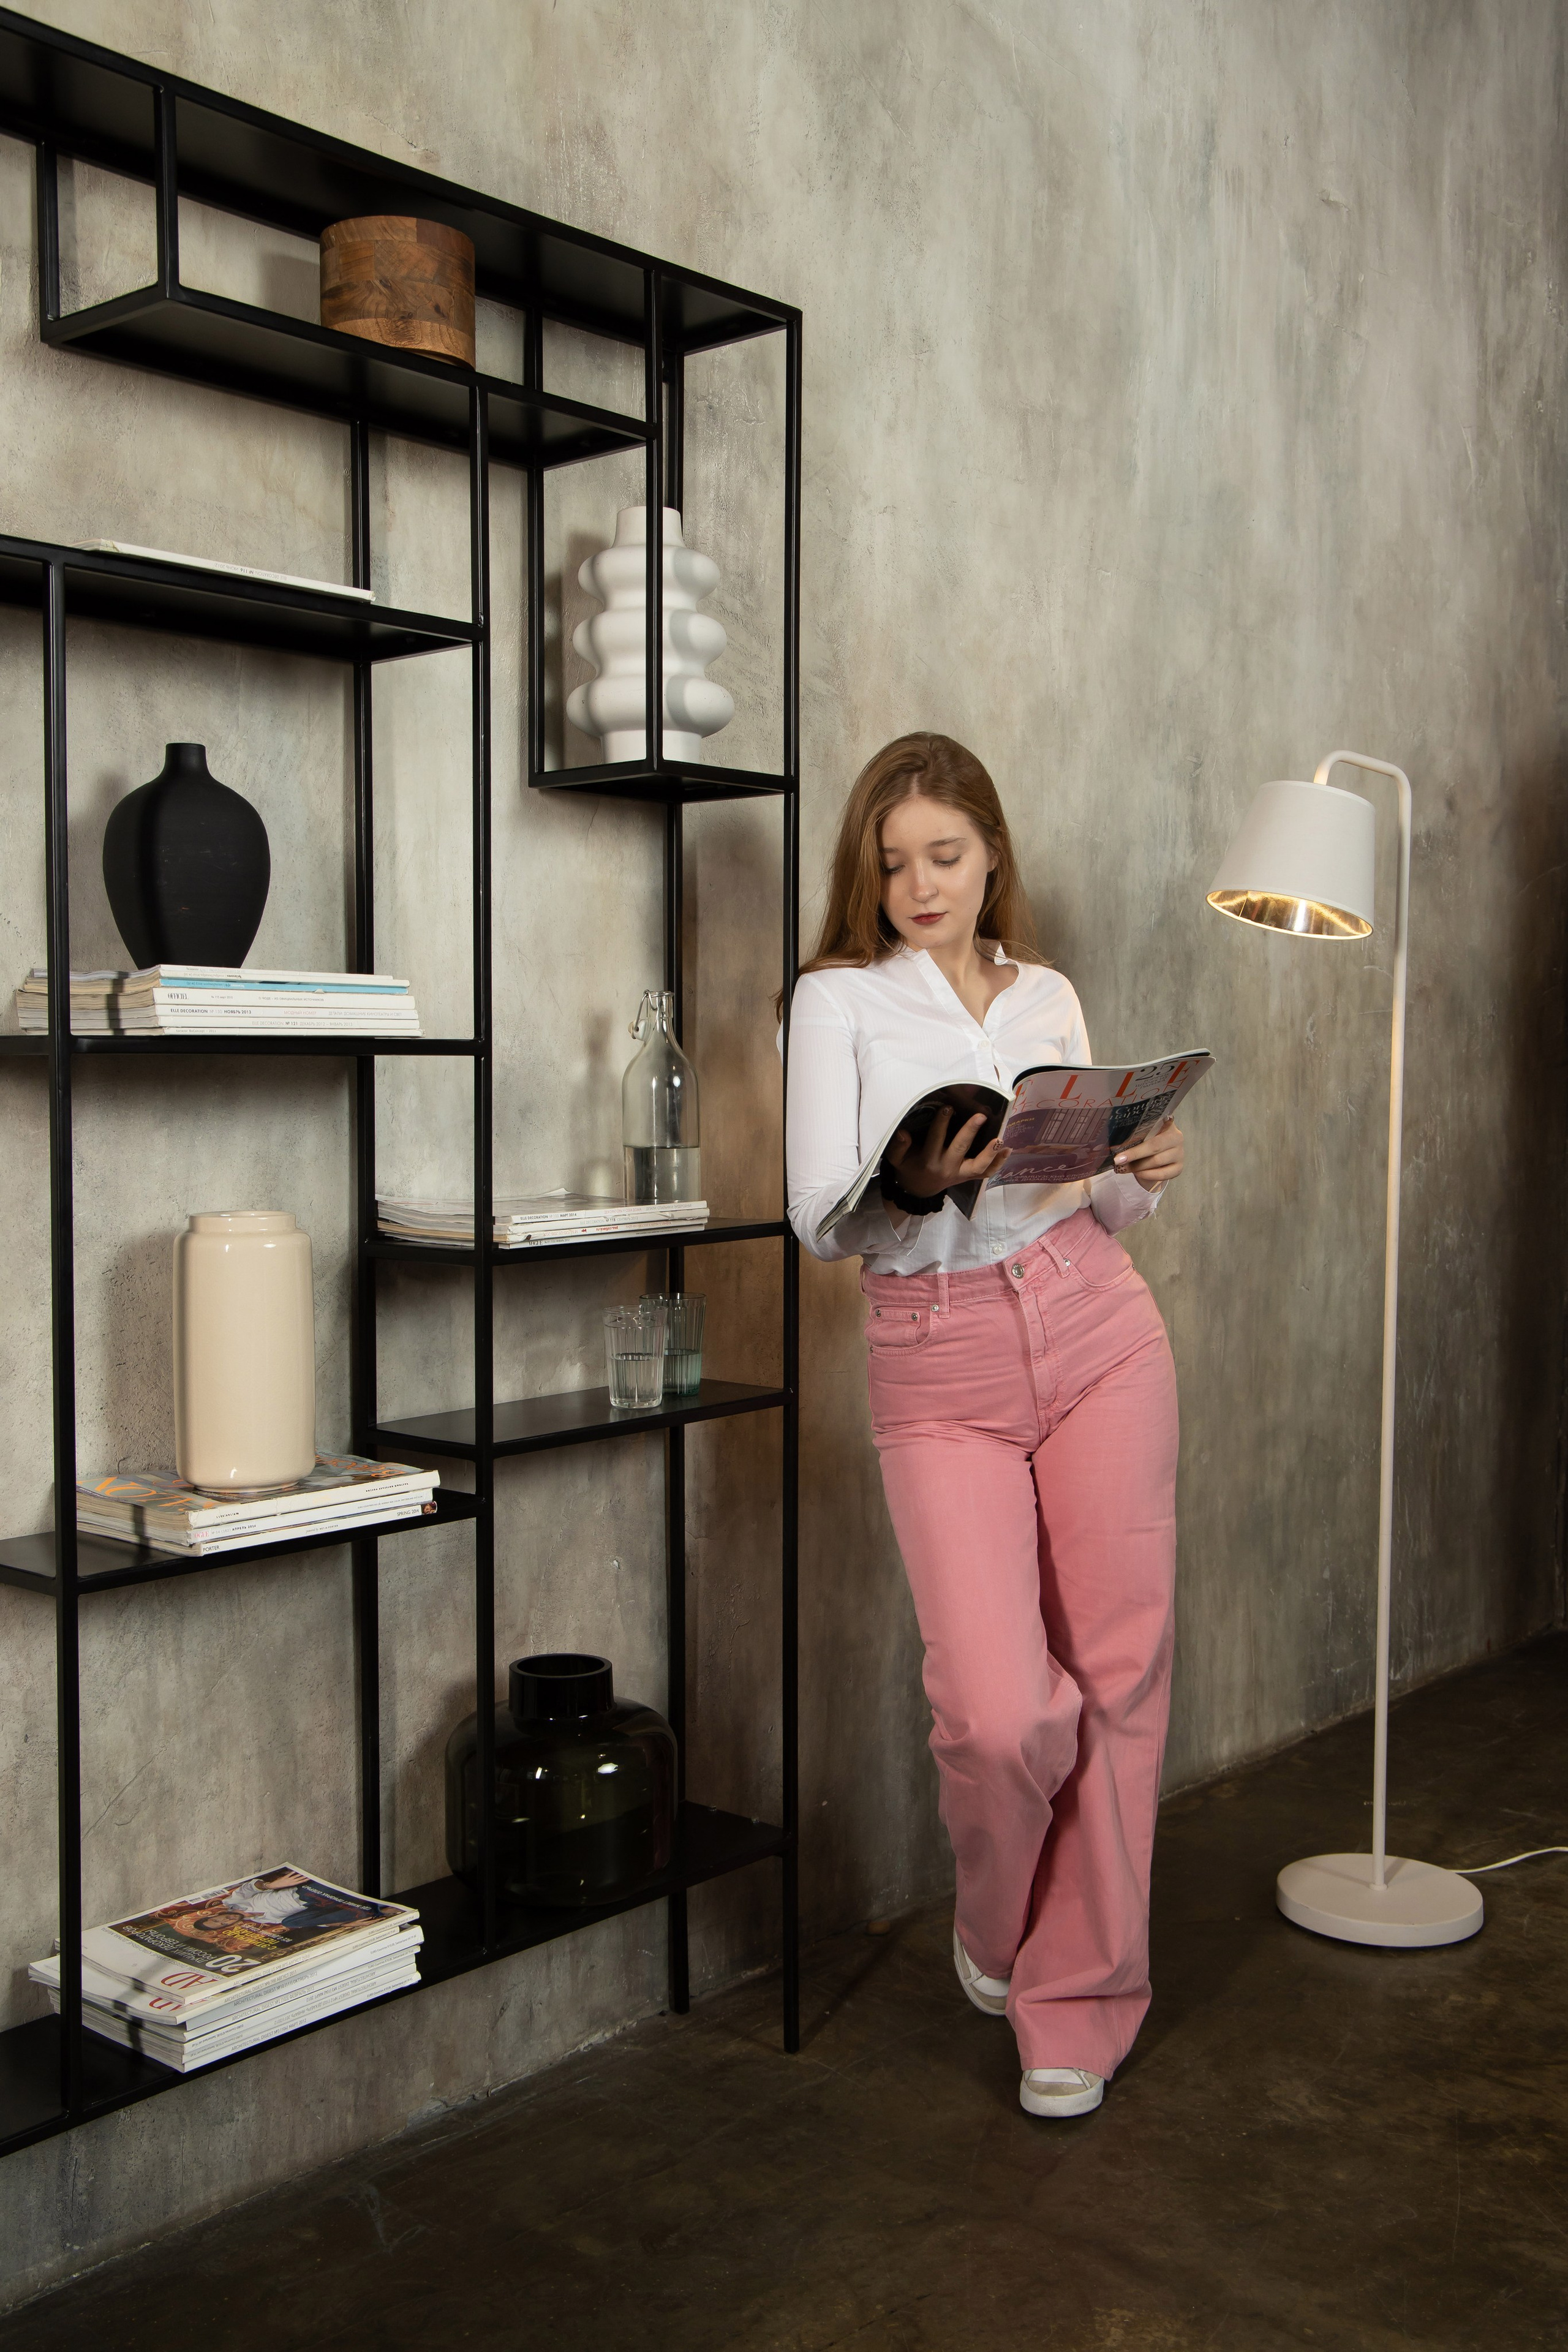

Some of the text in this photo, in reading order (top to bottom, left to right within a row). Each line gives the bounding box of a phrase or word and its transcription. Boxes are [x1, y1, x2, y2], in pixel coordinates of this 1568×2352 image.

[255, 571, 279, 579] DECORATION
[1135, 1060, 1178, 1082] 25
[1012, 1060, 1200, 1109] ELLE
[145, 1929, 179, 1945] ЕВРОПЫ
[222, 1930, 246, 1940] НАДО
[232, 1926, 279, 1945] ПЕРЕСПАТЬ
[246, 1937, 271, 1949] ЭТИМ
[123, 1924, 208, 1964] ЛУЧШИХ ДЕКОРАТОРОВ
[184, 1945, 217, 1960] РОССИИ
[205, 1954, 262, 1973] 20
[233, 1973, 262, 1986] ARCHITECTURAL
[288, 1958, 301, 1967] АВГУСТ
[350, 1971, 376, 1985] ARCHITECTURAL
[160, 1972, 219, 1990] AD
[224, 1989, 252, 2003] ARCHITECTURAL
[277, 1973, 289, 1982] АВГУСТ
[338, 1981, 350, 1991] DIGEST
[351, 1981, 377, 1995] ARCHITECTURAL
[234, 1992, 263, 2007] ARCHITECTURAL
[264, 1987, 276, 1996] DIGEST
[293, 1975, 310, 1985] ОКТЯБРЬ
[338, 1990, 350, 2000] DIGEST
[232, 2008, 261, 2021] ARCHITECTURAL
[262, 2002, 274, 2010] DIGEST
[290, 1991, 306, 2000] ФЕВРАЛЬ
[291, 2001, 322, 2017] ДЕКАБРЬ-ЯНВАРЬ
[274, 2015, 290, 2025] 2011/2012
[232, 2037, 260, 2051] ARCHITECTURAL
